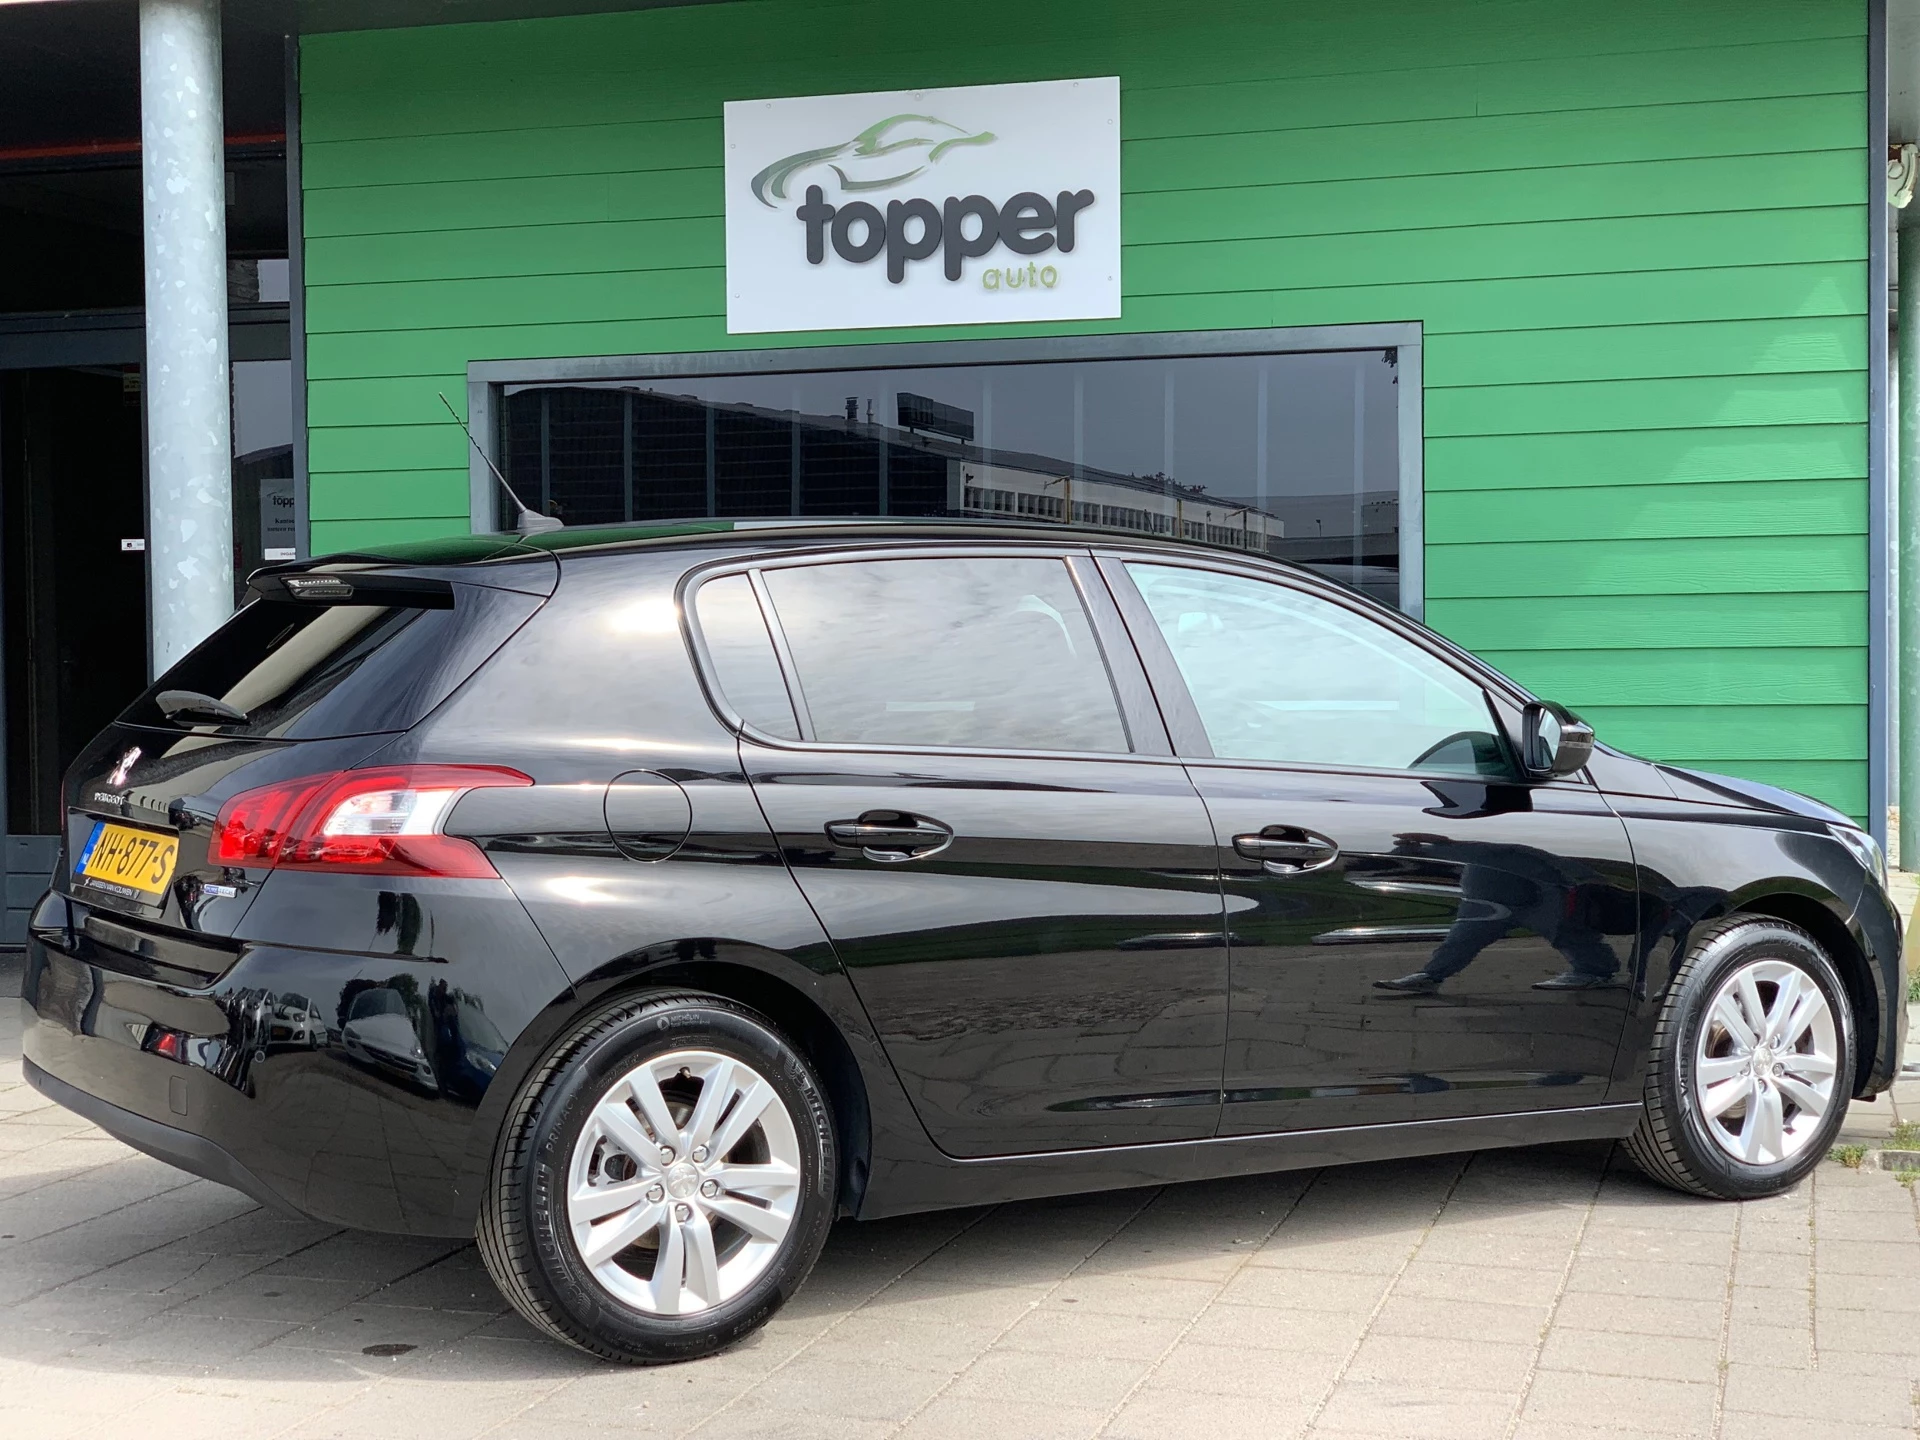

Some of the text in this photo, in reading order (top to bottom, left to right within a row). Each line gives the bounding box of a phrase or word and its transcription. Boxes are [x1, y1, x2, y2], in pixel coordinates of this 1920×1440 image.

[796, 184, 1094, 284] topper
[982, 261, 1058, 290] auto
[94, 792, 126, 805] PEUGEOT
[90, 831, 175, 885] NH-877-S
[803, 1087, 833, 1193] MICHELIN
[536, 1168, 567, 1284] MICHELIN
